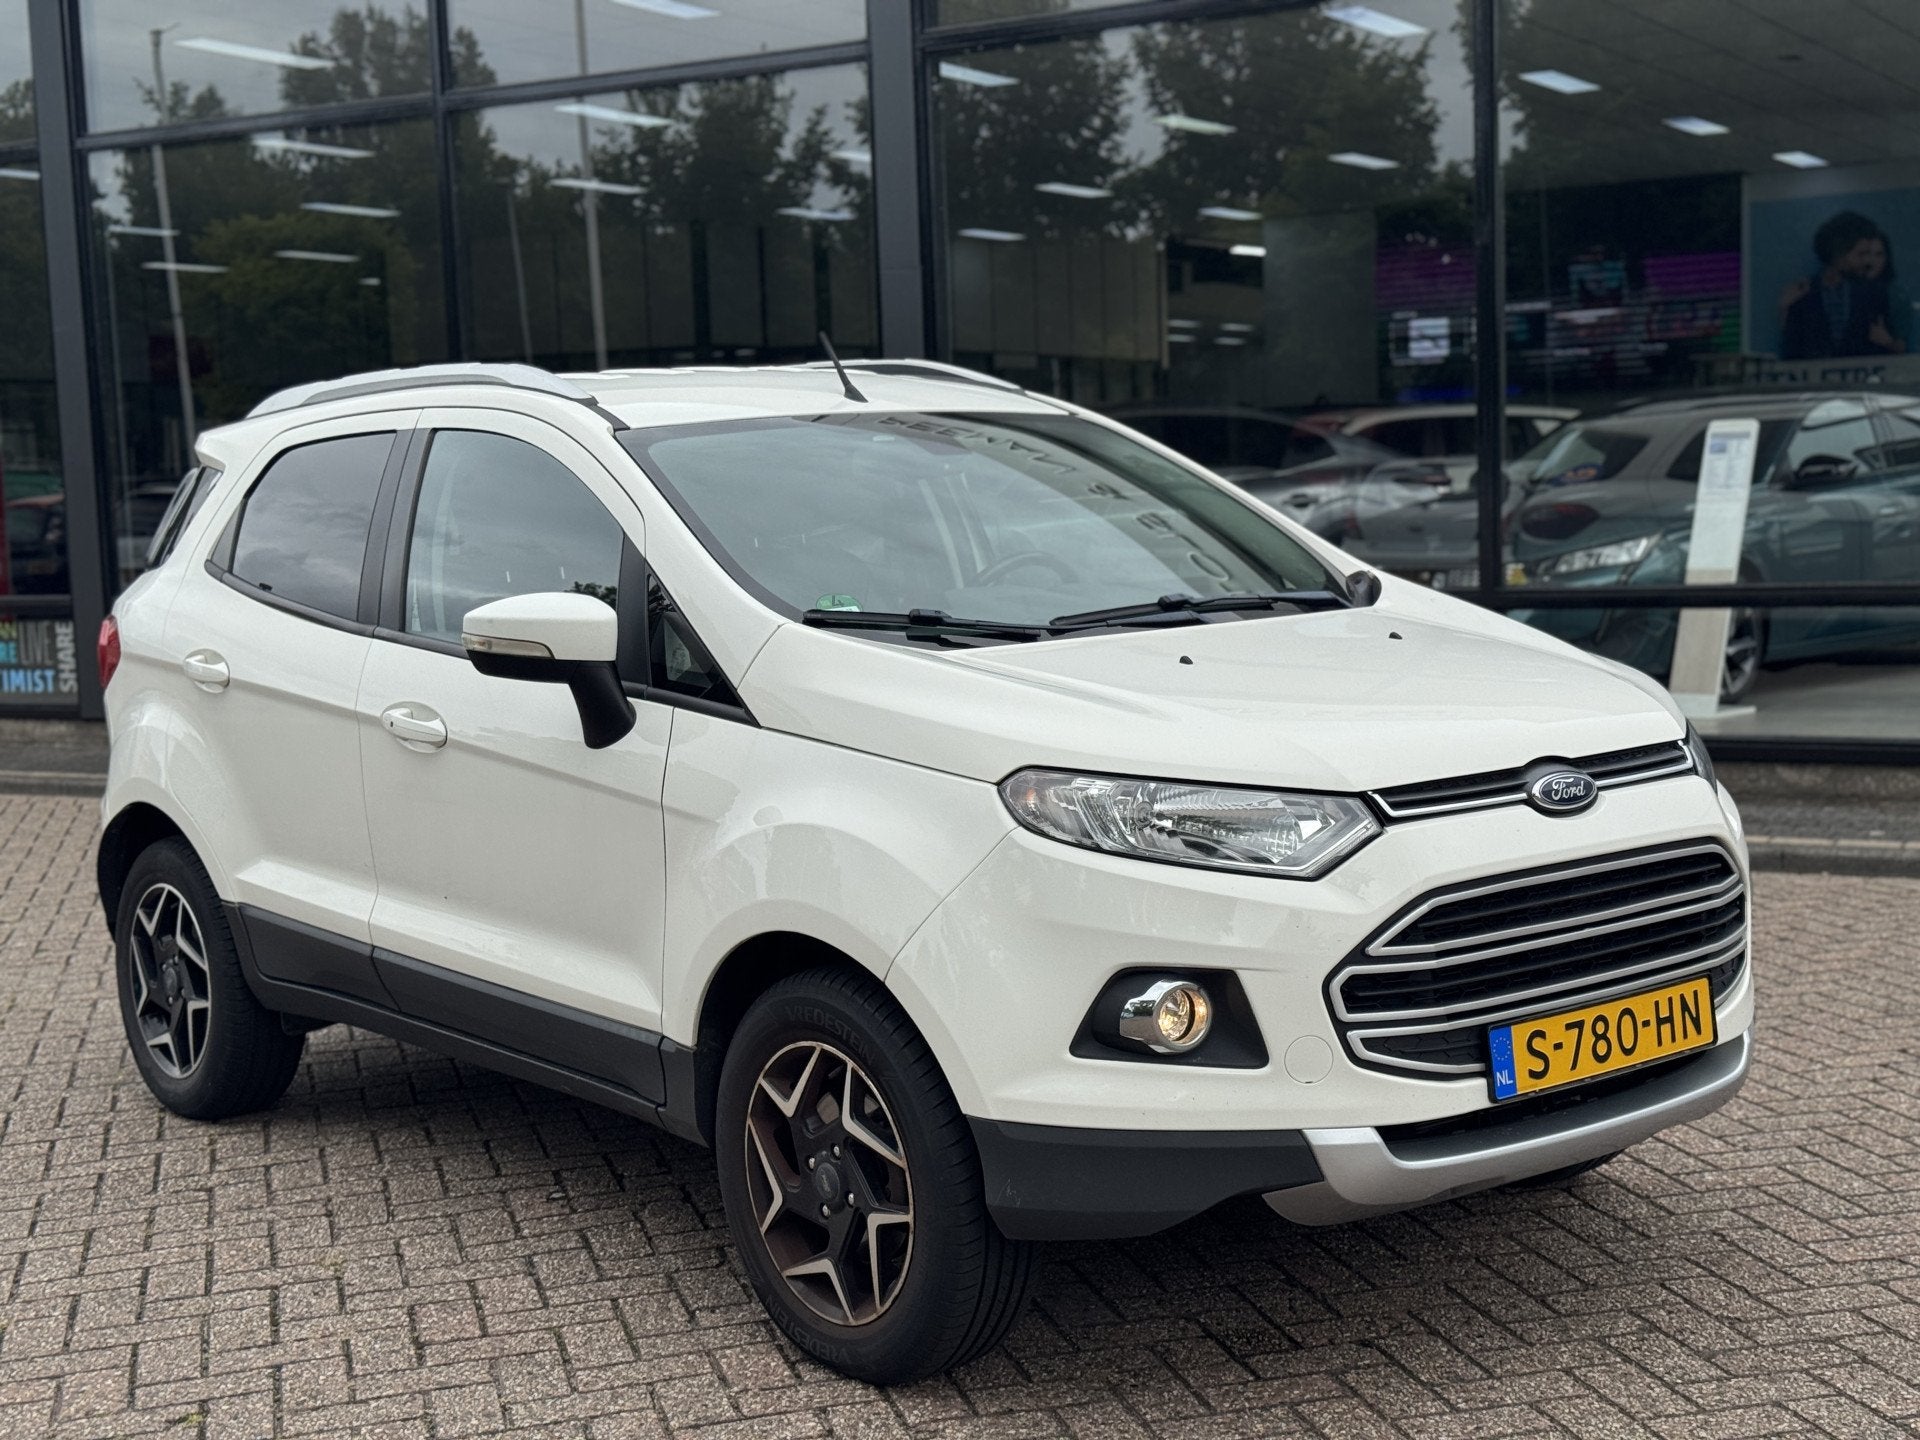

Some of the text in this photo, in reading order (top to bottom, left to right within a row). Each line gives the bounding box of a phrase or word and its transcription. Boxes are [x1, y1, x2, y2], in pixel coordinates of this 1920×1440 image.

[54, 620, 79, 694] SHARE
[1551, 777, 1586, 801] Ford
[784, 1004, 876, 1067] VREDESTEIN
[1525, 989, 1703, 1080] S-780-HN
[1496, 1069, 1514, 1087] NL
